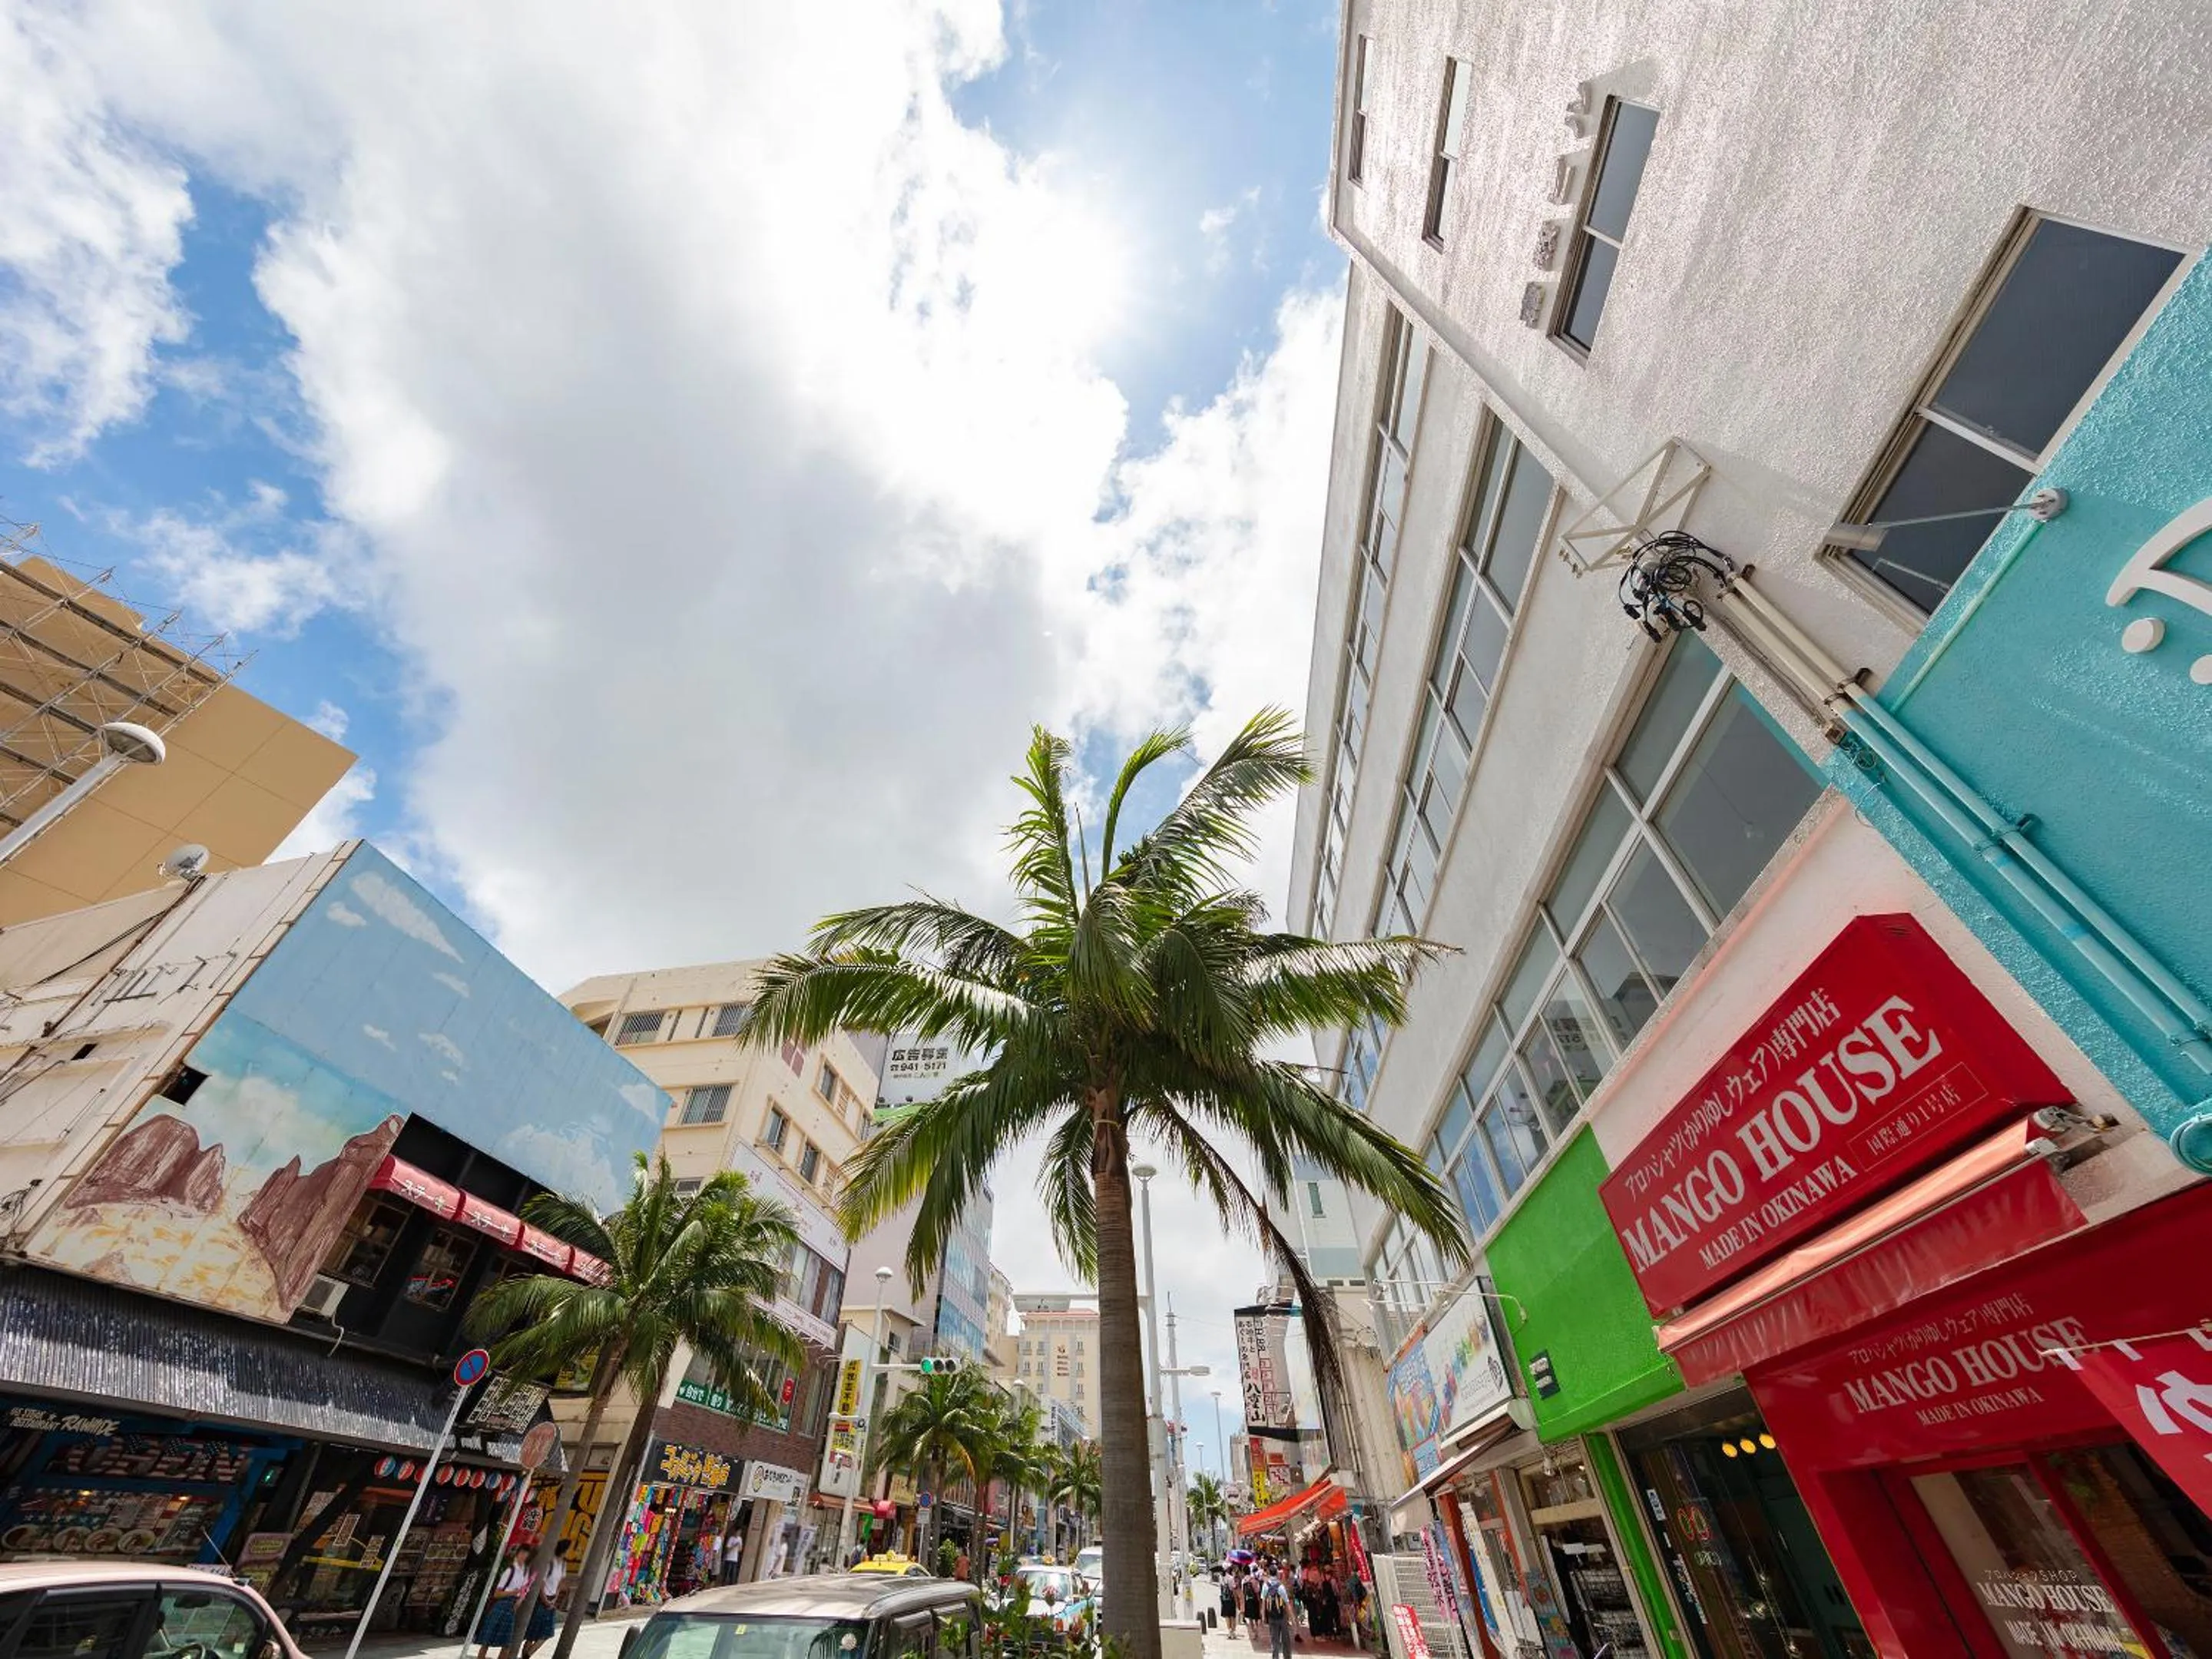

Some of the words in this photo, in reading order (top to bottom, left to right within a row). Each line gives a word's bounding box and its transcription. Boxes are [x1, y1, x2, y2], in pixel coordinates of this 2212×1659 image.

[1621, 1149, 1745, 1273] MANGO
[1735, 995, 1943, 1182] HOUSE
[1698, 1226, 1745, 1270] MADE
[1739, 1211, 1765, 1243] IN
[1760, 1155, 1858, 1227] OKINAWA
[1844, 1356, 1958, 1414] MANGO
[1951, 1316, 2101, 1386] HOUSE
[1916, 1405, 1956, 1426] MADE
[1952, 1401, 1973, 1419] IN
[1970, 1386, 2045, 1416] OKINAWA
[1976, 1581, 2047, 1610] MANGO
[2039, 1584, 2117, 1613] HOUSE
